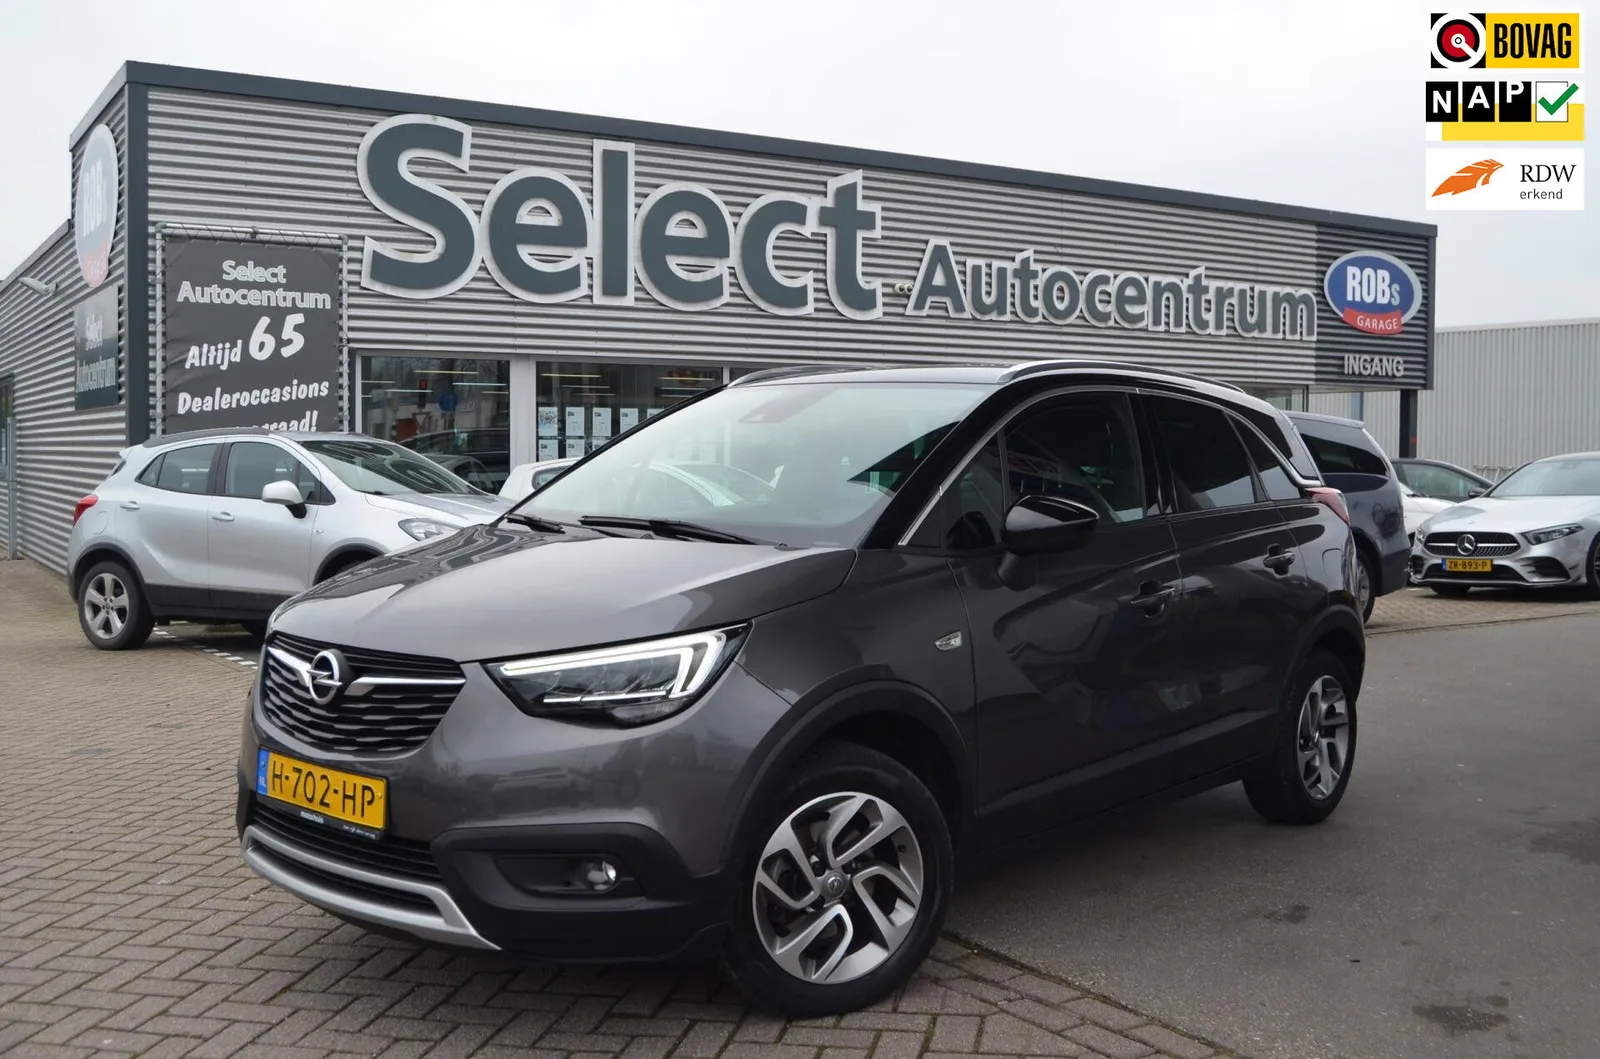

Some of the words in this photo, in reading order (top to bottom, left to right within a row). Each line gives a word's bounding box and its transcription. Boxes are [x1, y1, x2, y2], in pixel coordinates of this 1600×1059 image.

[357, 113, 883, 321] Select
[905, 238, 1318, 343] Autocentrum
[221, 259, 287, 284] Select
[1346, 265, 1401, 306] ROBs
[176, 280, 332, 310] Autocentrum
[1357, 315, 1399, 331] GARAGE
[184, 339, 242, 371] Altijd
[248, 312, 306, 361] 65
[1343, 354, 1405, 378] INGANG
[177, 379, 330, 415] Dealeroccasions
[1447, 560, 1488, 570] ZR-893-P
[272, 759, 377, 818] H-702-HP
